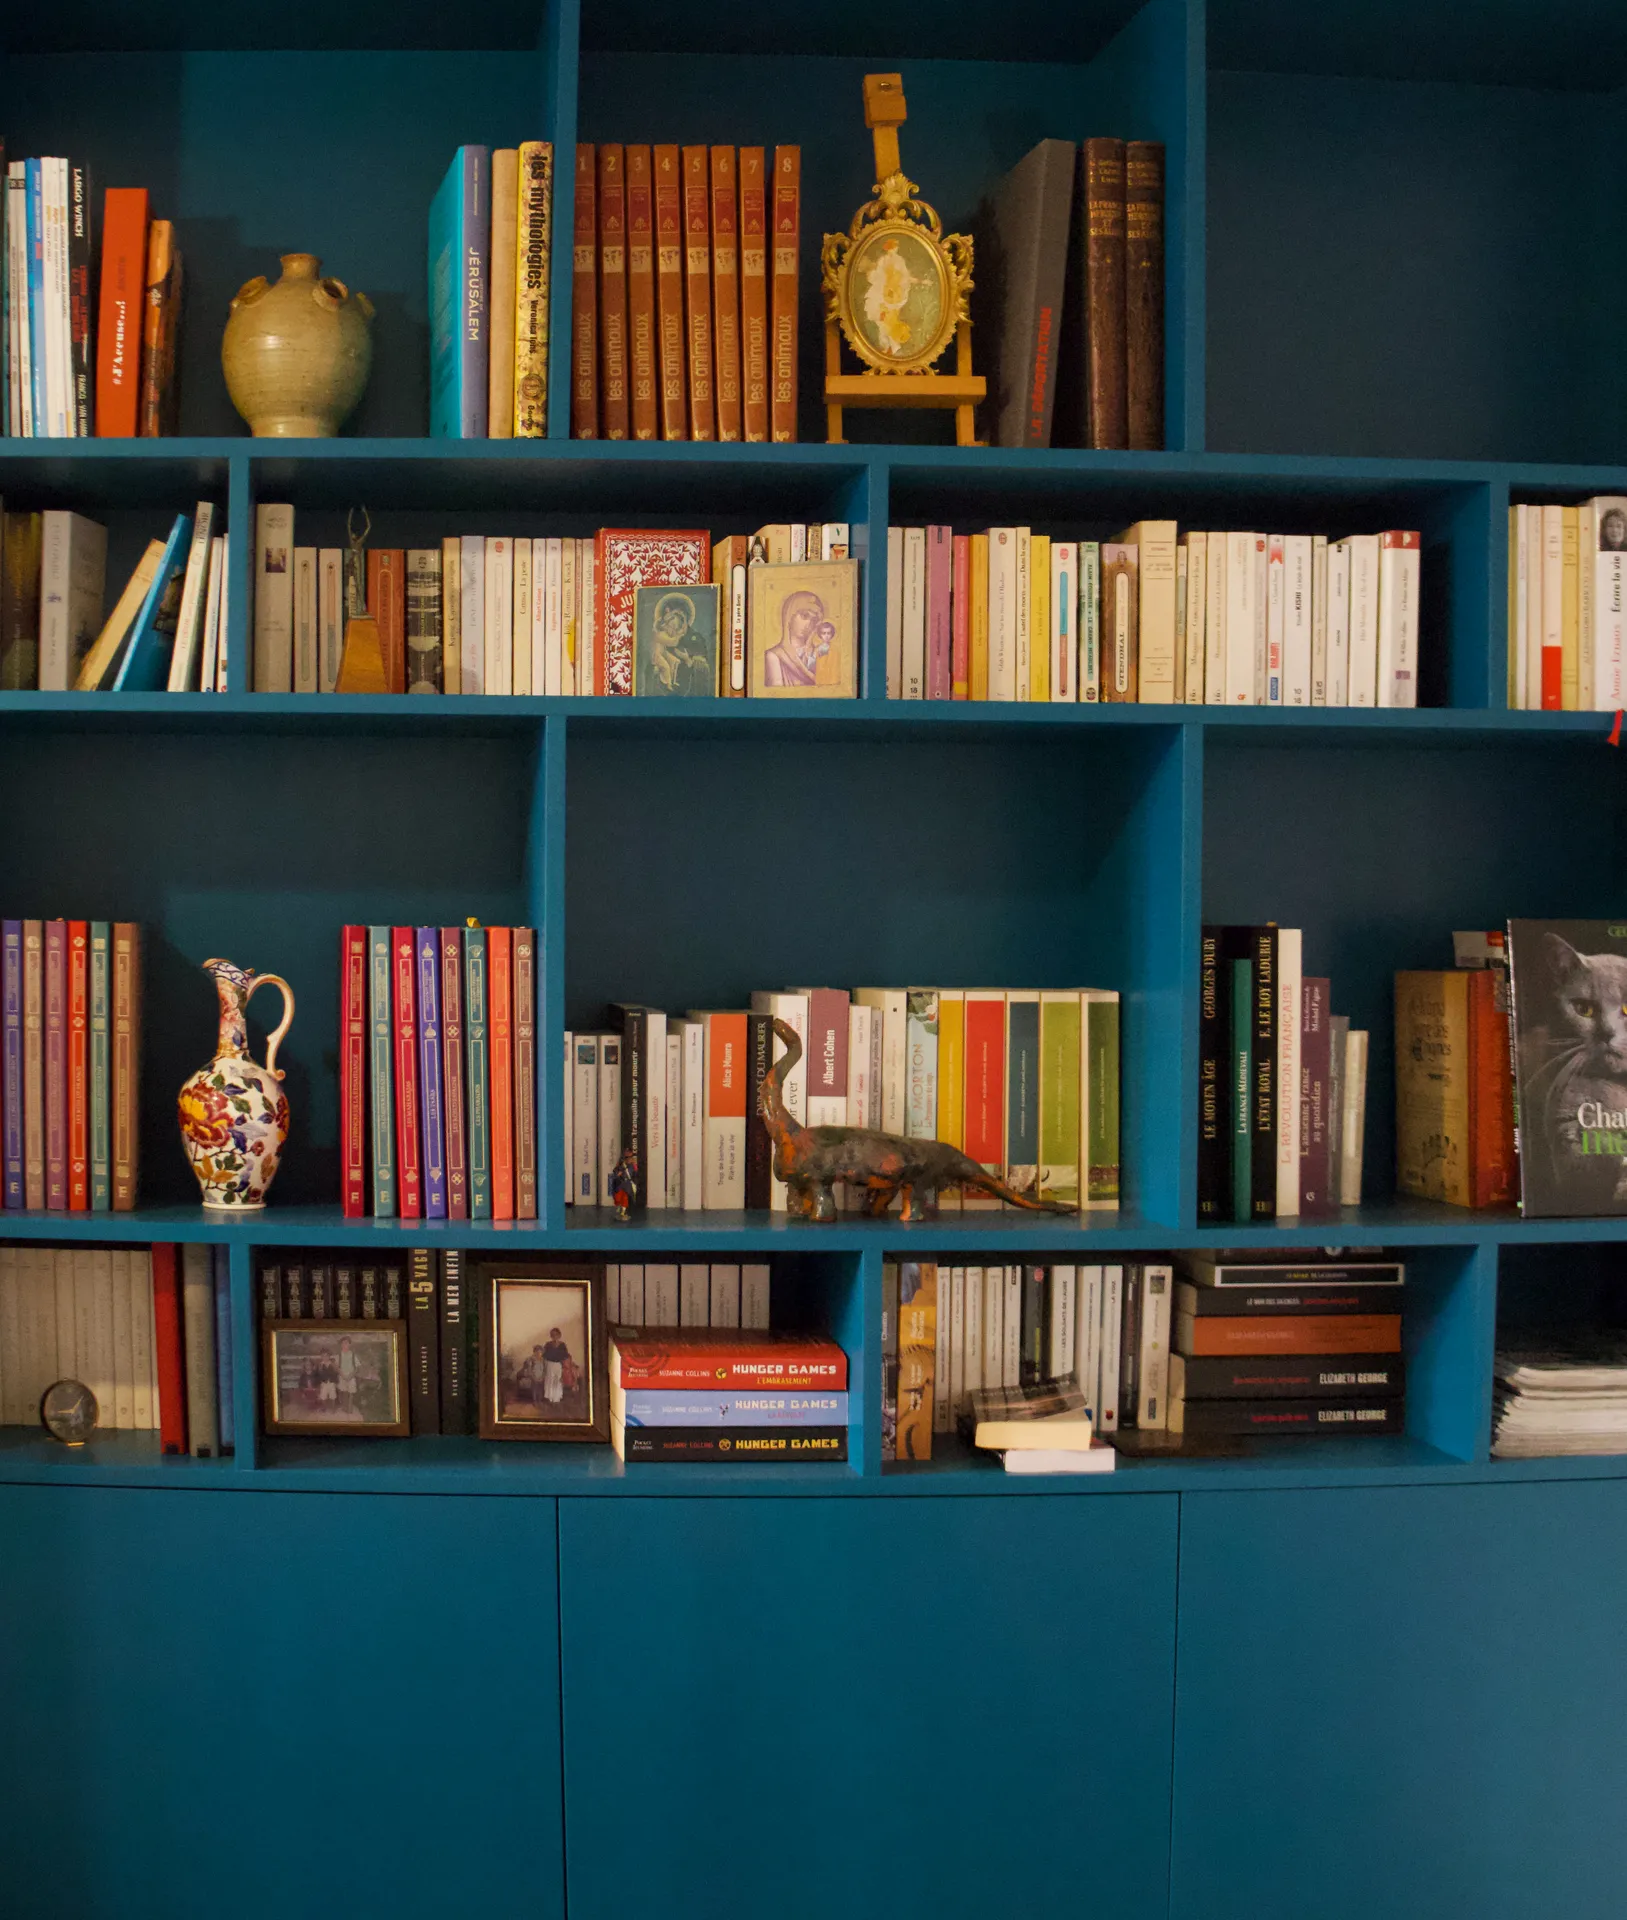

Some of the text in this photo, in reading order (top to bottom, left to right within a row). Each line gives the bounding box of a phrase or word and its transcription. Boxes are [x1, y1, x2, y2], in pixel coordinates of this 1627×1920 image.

[531, 155, 548, 180] les
[579, 156, 586, 172] 1
[606, 156, 616, 172] 2
[634, 156, 643, 172] 3
[661, 156, 671, 172] 4
[691, 157, 700, 173] 5
[719, 157, 728, 173] 6
[747, 159, 757, 175] 7
[781, 157, 791, 173] 8
[73, 168, 83, 237] LARGO WINCH
[526, 187, 547, 289] mythologies
[467, 247, 483, 341] JÉRUSALEM
[529, 299, 540, 334] Veronica
[577, 312, 592, 400] les animaux
[607, 313, 623, 400] les animaux
[635, 313, 651, 400] les animaux
[664, 313, 680, 400] les animaux
[693, 314, 708, 401] les animaux
[720, 314, 736, 402] les animaux
[748, 317, 764, 404] les animaux
[776, 315, 792, 403] les animaux
[1611, 555, 1621, 570] vie
[733, 629, 742, 660] BALZAC
[910, 677, 918, 685] 10
[1259, 936, 1271, 983] LADURIE
[1259, 986, 1271, 1009] ROY
[1259, 1010, 1271, 1025] LE
[1281, 984, 1294, 1059] FRANÇAISE
[756, 1021, 766, 1061] MAURIER
[1202, 937, 1216, 1139] LE MOYEN ÂGE GEORGES DUBY
[721, 1043, 732, 1089] Alice Munro
[823, 1029, 835, 1085] Albert Cohen
[756, 1062, 765, 1078] DU
[911, 1043, 924, 1109] MORTON
[1257, 1058, 1271, 1093] ROYAL
[789, 1081, 798, 1106] ever
[1300, 1068, 1310, 1101] France
[651, 1096, 659, 1122] beauté
[1257, 1094, 1271, 1131] L'ÉTAT
[1281, 1062, 1293, 1146] RÉVOLUTION
[1310, 1080, 1324, 1143] au quotidien
[631, 1099, 639, 1136] tranquille
[651, 1132, 659, 1149] Vers
[717, 1134, 726, 1161] bonheur
[717, 1171, 726, 1186] Trop
[727, 1165, 735, 1181] Rien
[409, 1281, 434, 1293] 5
[447, 1285, 459, 1305] MER
[415, 1296, 428, 1311] LA
[447, 1311, 459, 1323] LA
[659, 1369, 710, 1377] SUZANNE COLLINS
[732, 1364, 837, 1375] HUNGER GAMES
[756, 1377, 812, 1385] L'EMBRASEMENT
[1319, 1373, 1356, 1385] ELIZABETH
[1357, 1372, 1389, 1385] GEORGE
[735, 1399, 838, 1409] HUNGER GAMES
[1317, 1409, 1388, 1422] ELIZABETH GEORGE
[735, 1438, 839, 1450] HUNGER GAMES
